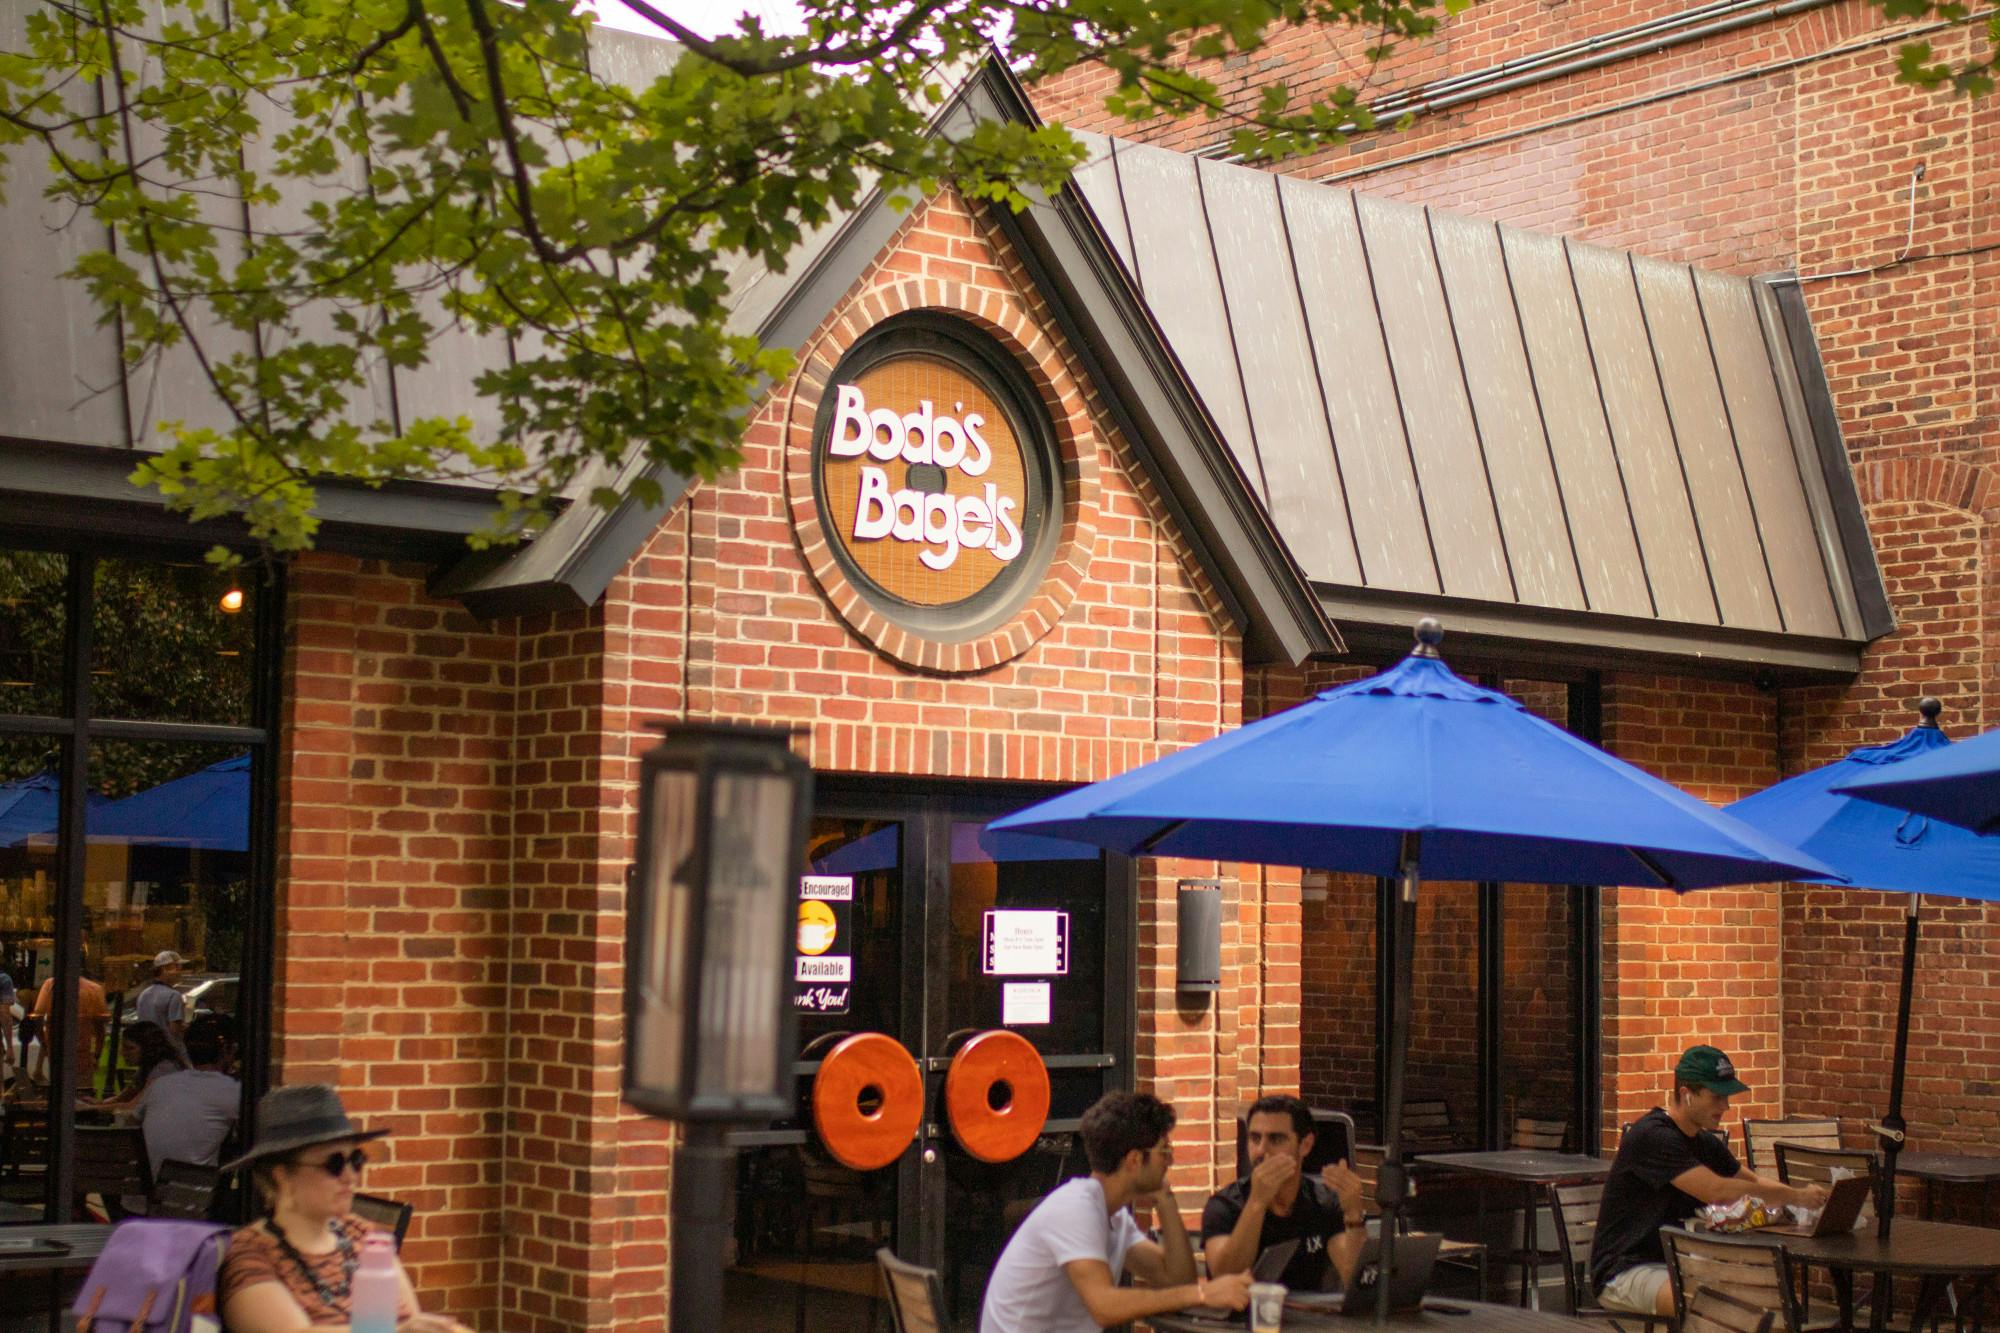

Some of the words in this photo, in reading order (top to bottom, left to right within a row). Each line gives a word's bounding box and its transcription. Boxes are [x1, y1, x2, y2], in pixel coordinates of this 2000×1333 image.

[830, 384, 992, 477] Bodo's
[853, 466, 1023, 570] Bagels
[804, 881, 850, 897] Encouraged
[801, 961, 844, 976] Available
[815, 987, 848, 1011] You!
